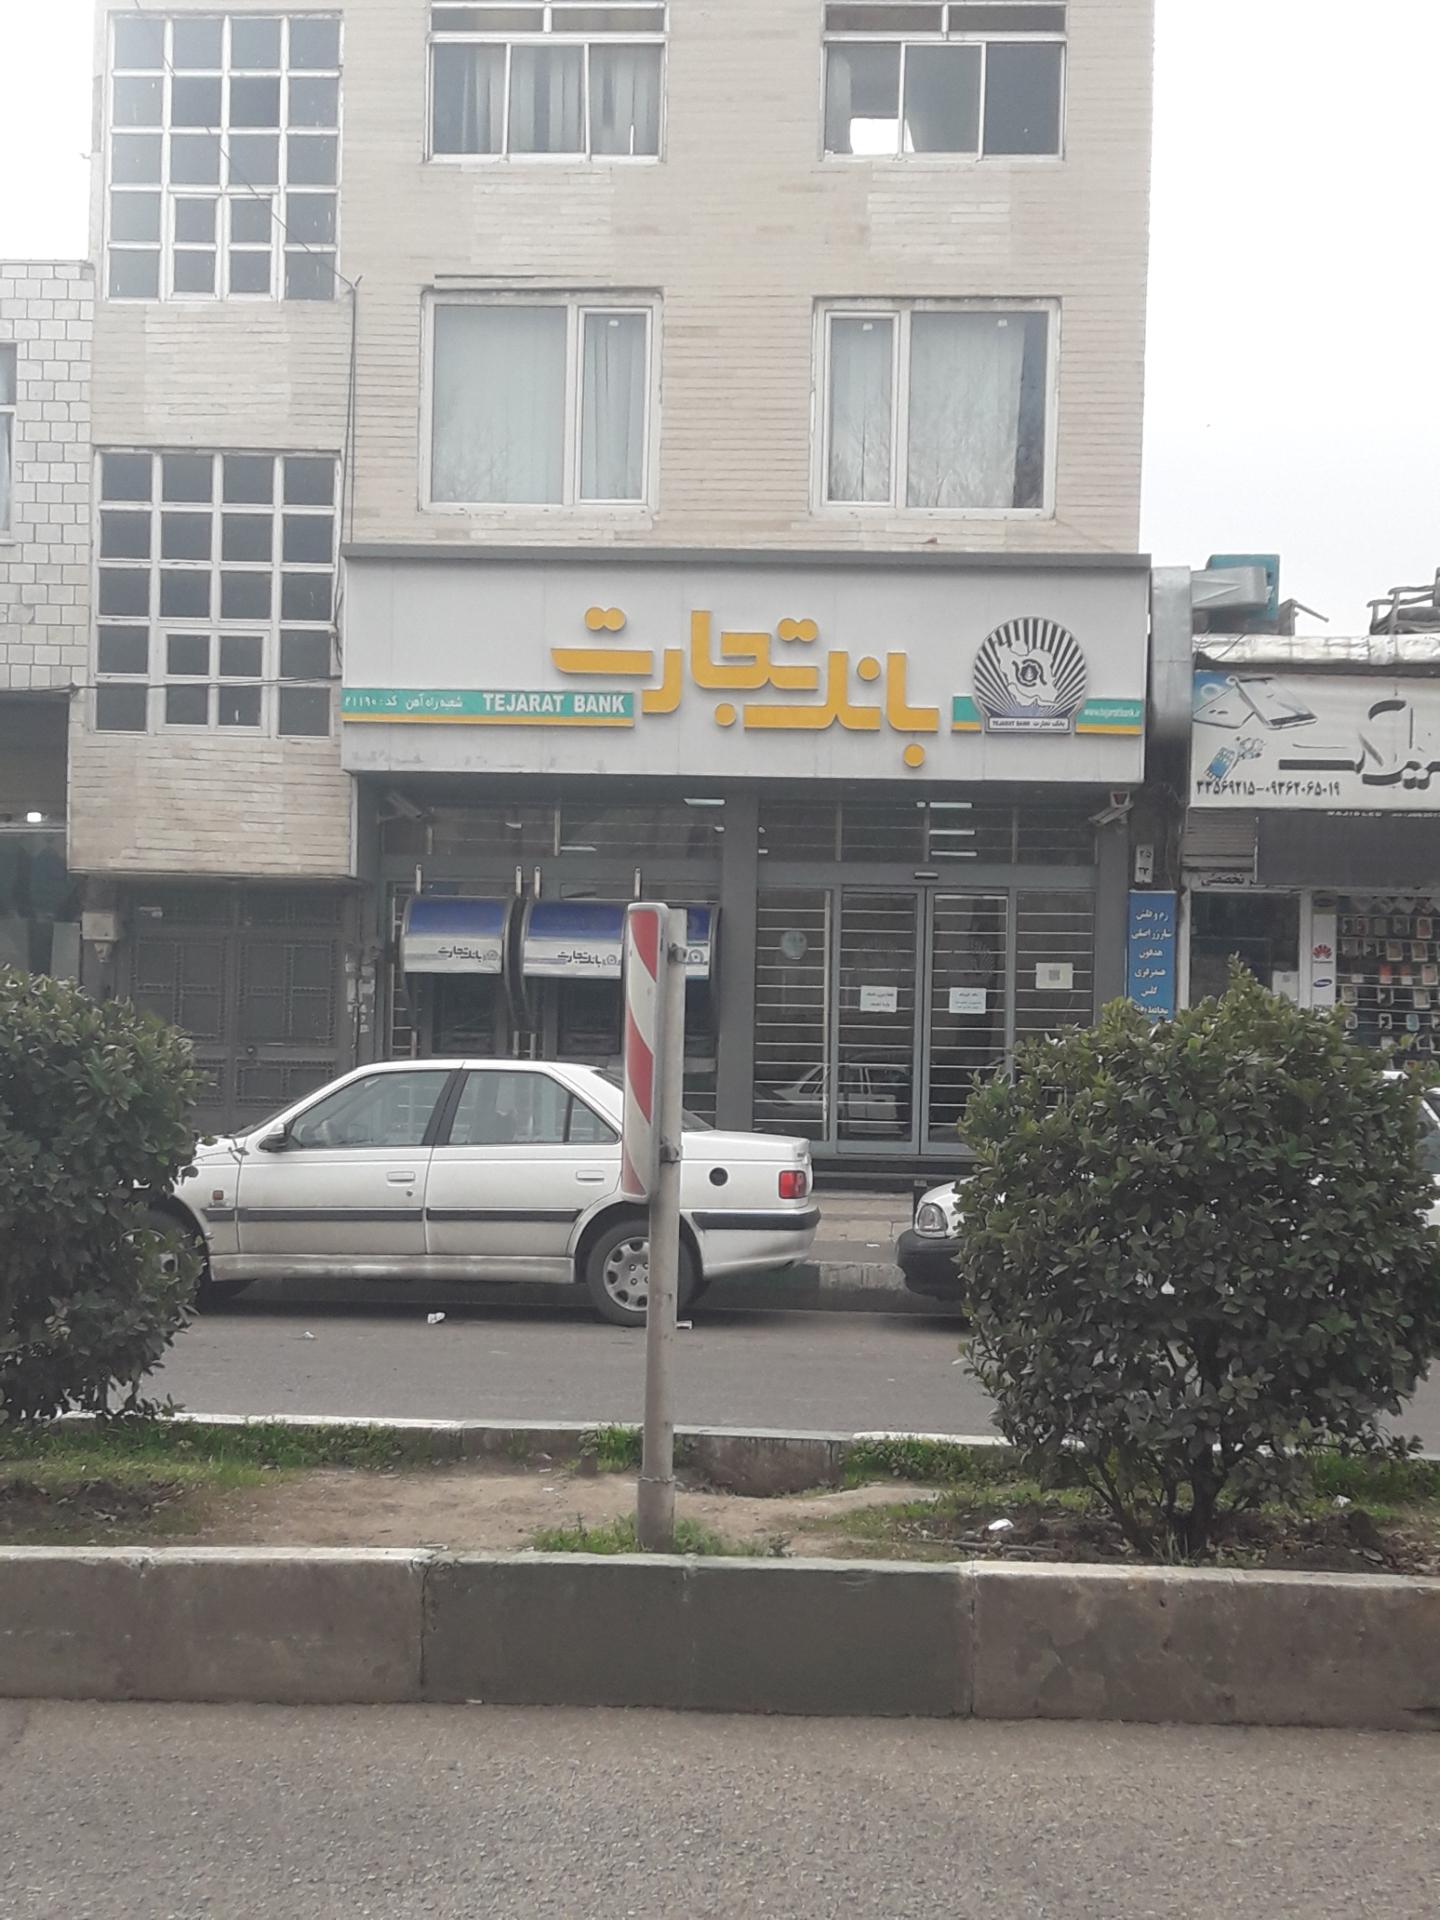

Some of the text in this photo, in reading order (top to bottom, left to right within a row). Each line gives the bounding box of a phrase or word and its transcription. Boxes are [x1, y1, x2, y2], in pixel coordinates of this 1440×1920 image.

[551, 606, 939, 768] بانک تجارت
[482, 693, 625, 713] TEJARAT BANK
[438, 945, 482, 963] بانک تجارت
[557, 950, 602, 968] بانک تجارت
